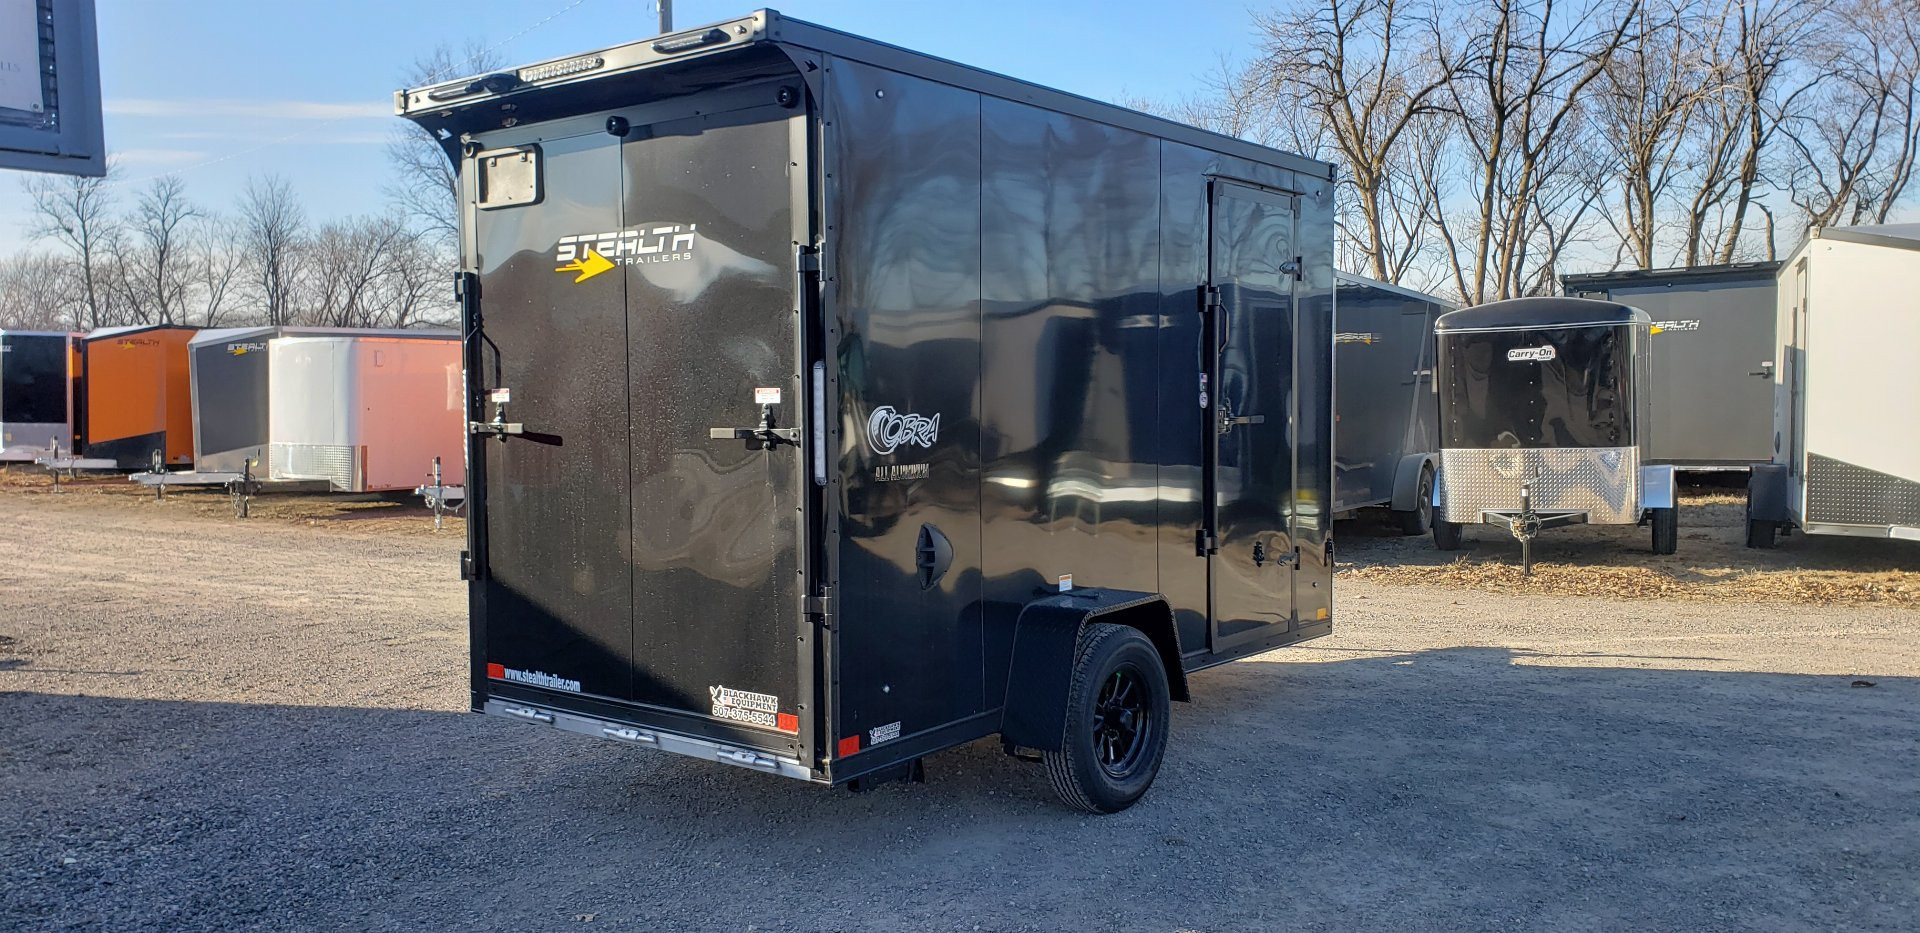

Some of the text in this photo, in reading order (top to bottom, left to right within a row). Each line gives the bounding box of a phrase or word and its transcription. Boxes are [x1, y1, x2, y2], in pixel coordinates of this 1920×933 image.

[556, 223, 696, 261] STEALTH
[615, 252, 692, 266] TRAILERS
[1508, 348, 1552, 359] Carry-On
[867, 405, 940, 455] COBRA
[875, 466, 890, 482] ALL
[503, 667, 581, 693] www.stealthtrailer.com
[723, 690, 777, 704] BLACKHAWK
[731, 698, 777, 711] EQUIPMENT
[713, 706, 775, 725] 507-375-5544
